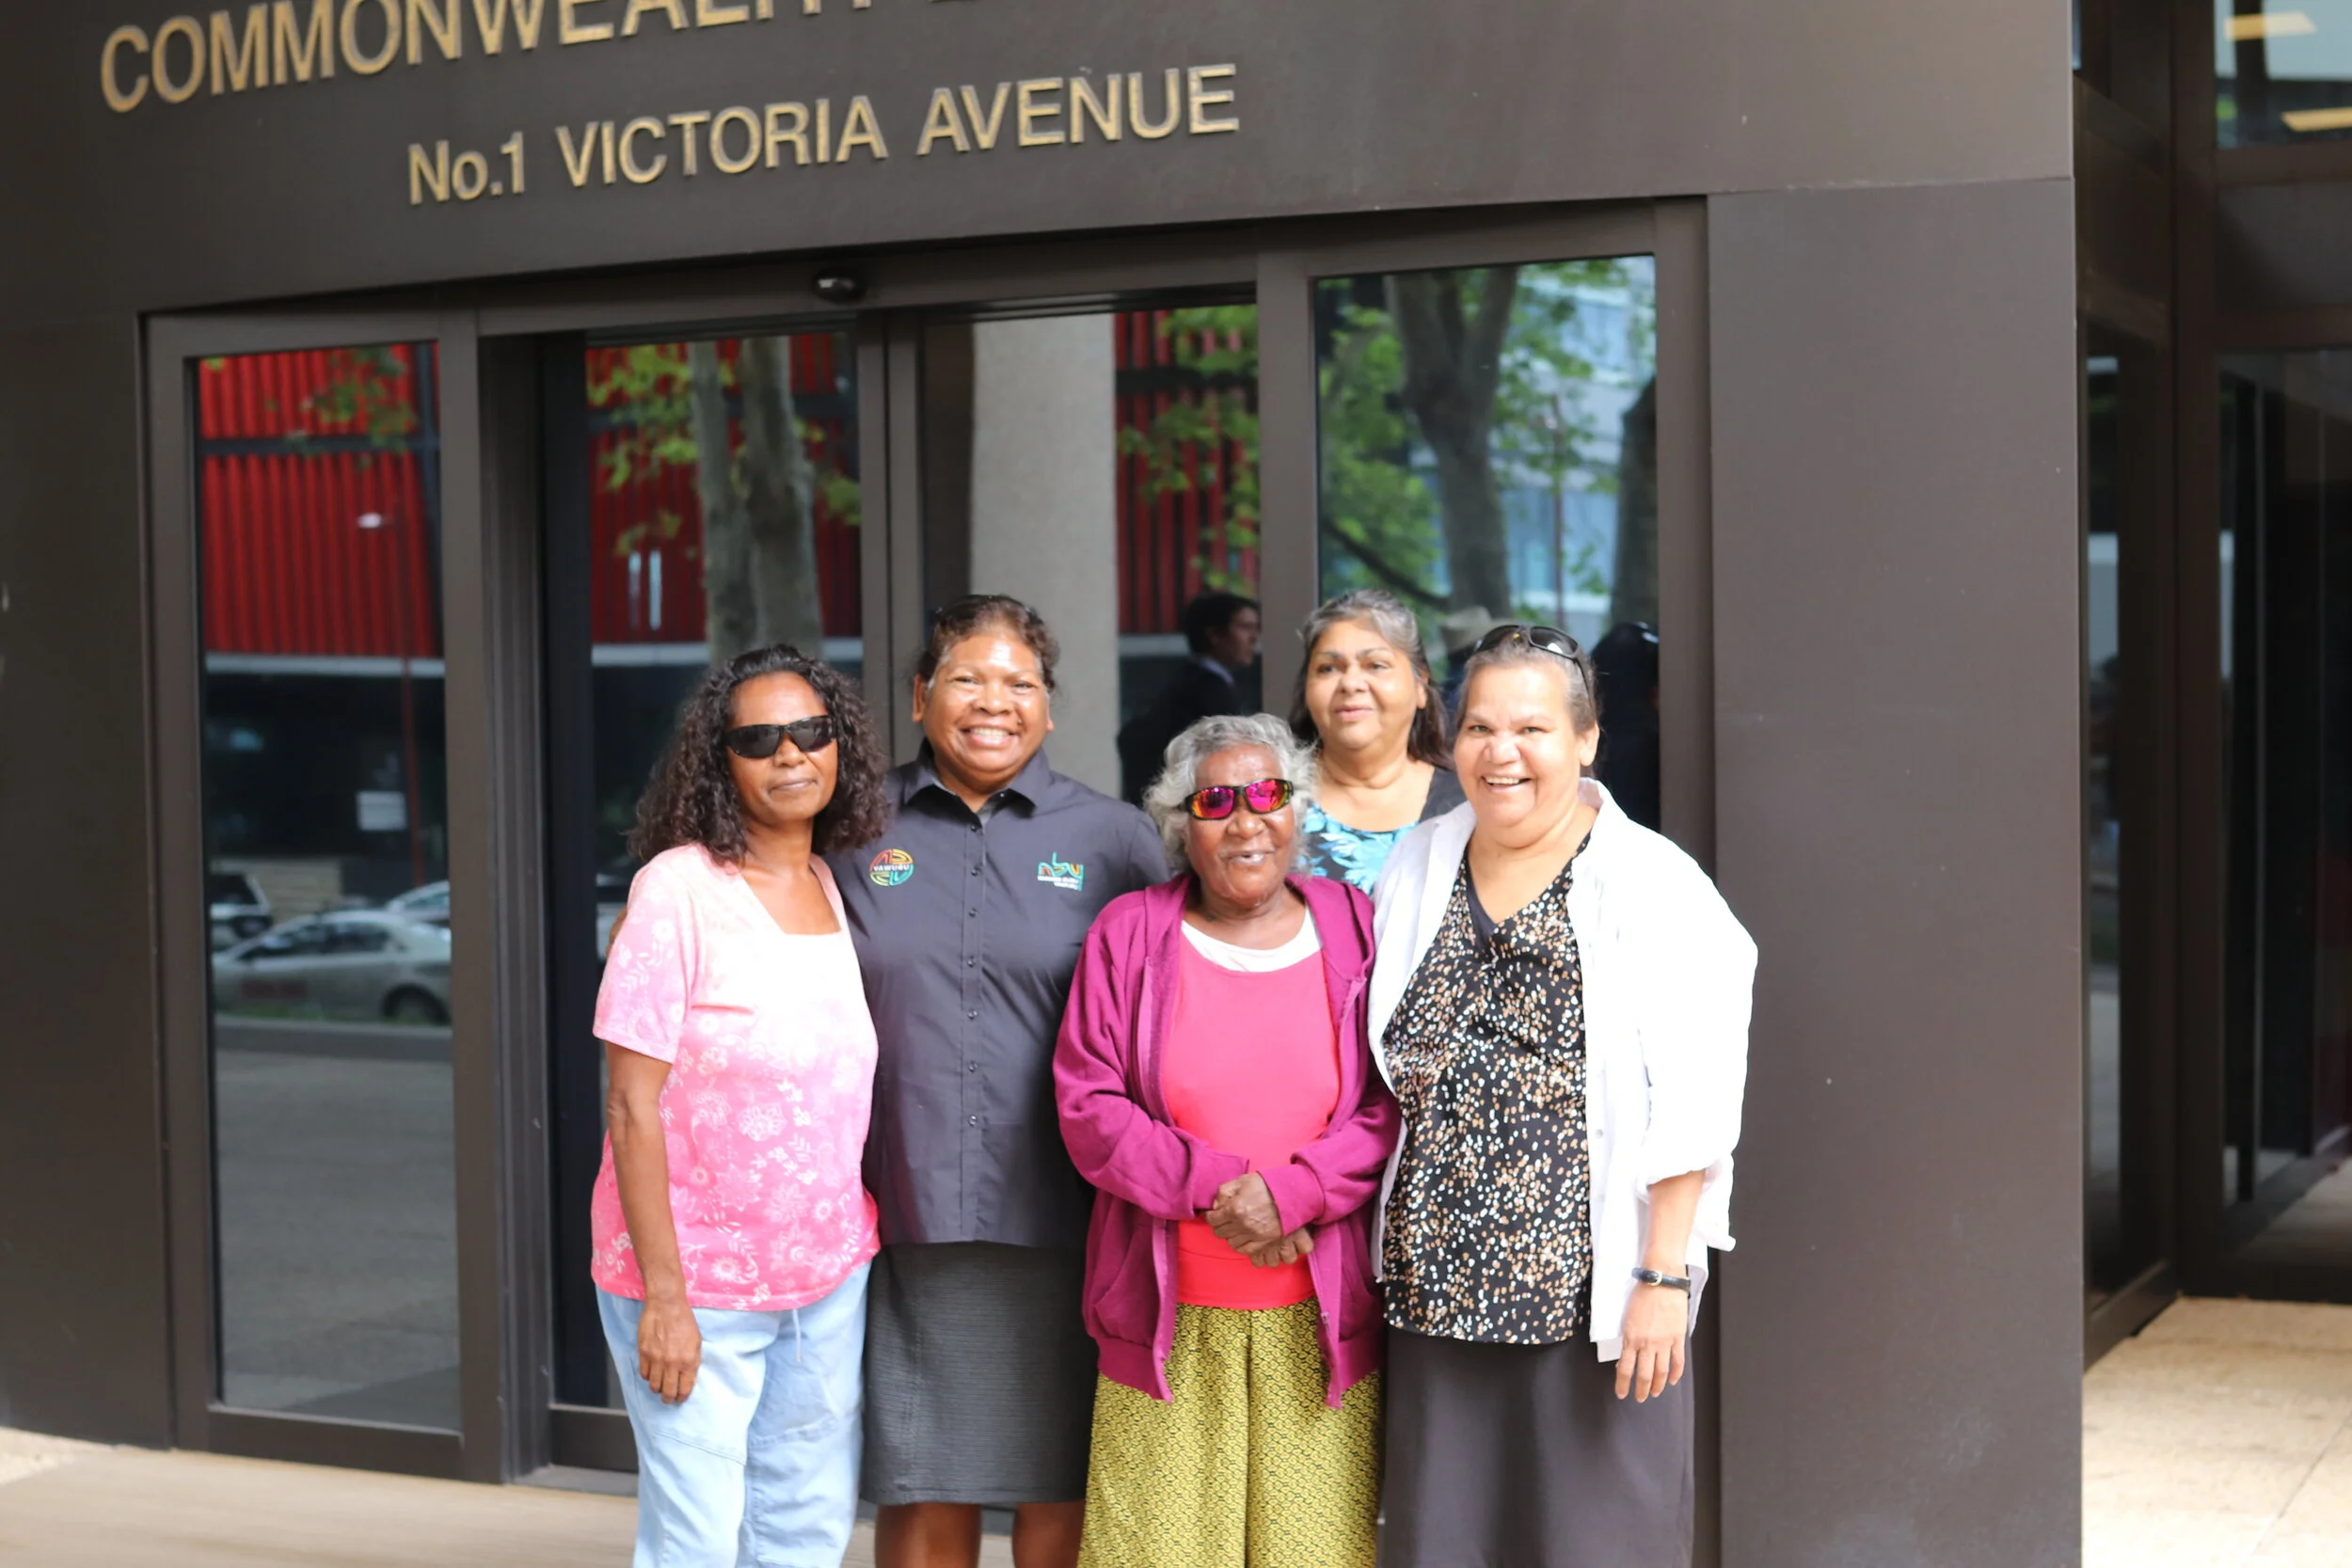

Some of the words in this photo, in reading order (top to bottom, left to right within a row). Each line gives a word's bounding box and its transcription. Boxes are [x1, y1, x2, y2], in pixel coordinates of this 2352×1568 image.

[101, 0, 871, 112] COMMONWE
[408, 133, 524, 205] No.1
[556, 97, 887, 187] VICTORIA
[916, 63, 1239, 156] AVENUE
